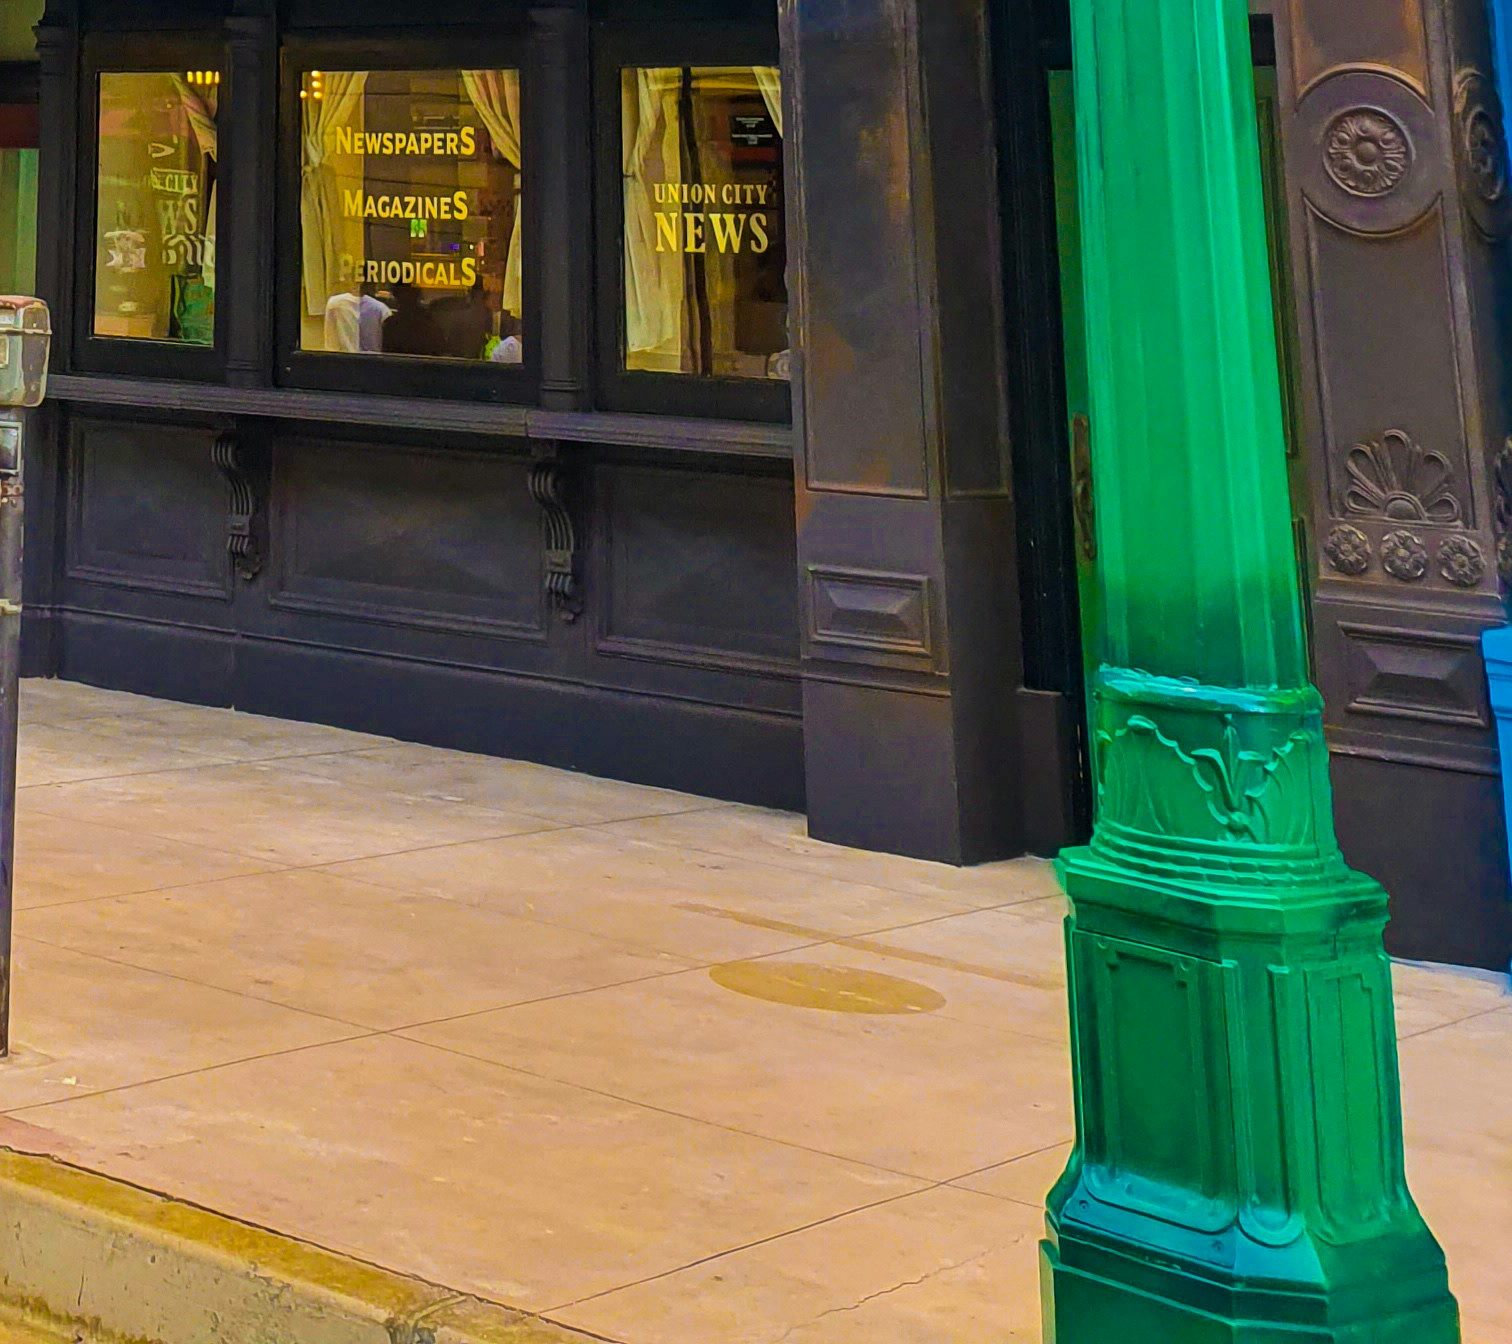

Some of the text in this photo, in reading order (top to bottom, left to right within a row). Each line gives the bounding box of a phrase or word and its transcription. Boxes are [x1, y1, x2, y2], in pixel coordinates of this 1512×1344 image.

[336, 126, 476, 156] NEWSPAPERS
[343, 189, 469, 220] MAGAZINES
[653, 183, 769, 205] UNION CITY
[654, 212, 769, 254] NEWS
[337, 253, 477, 287] PERIODICALS
